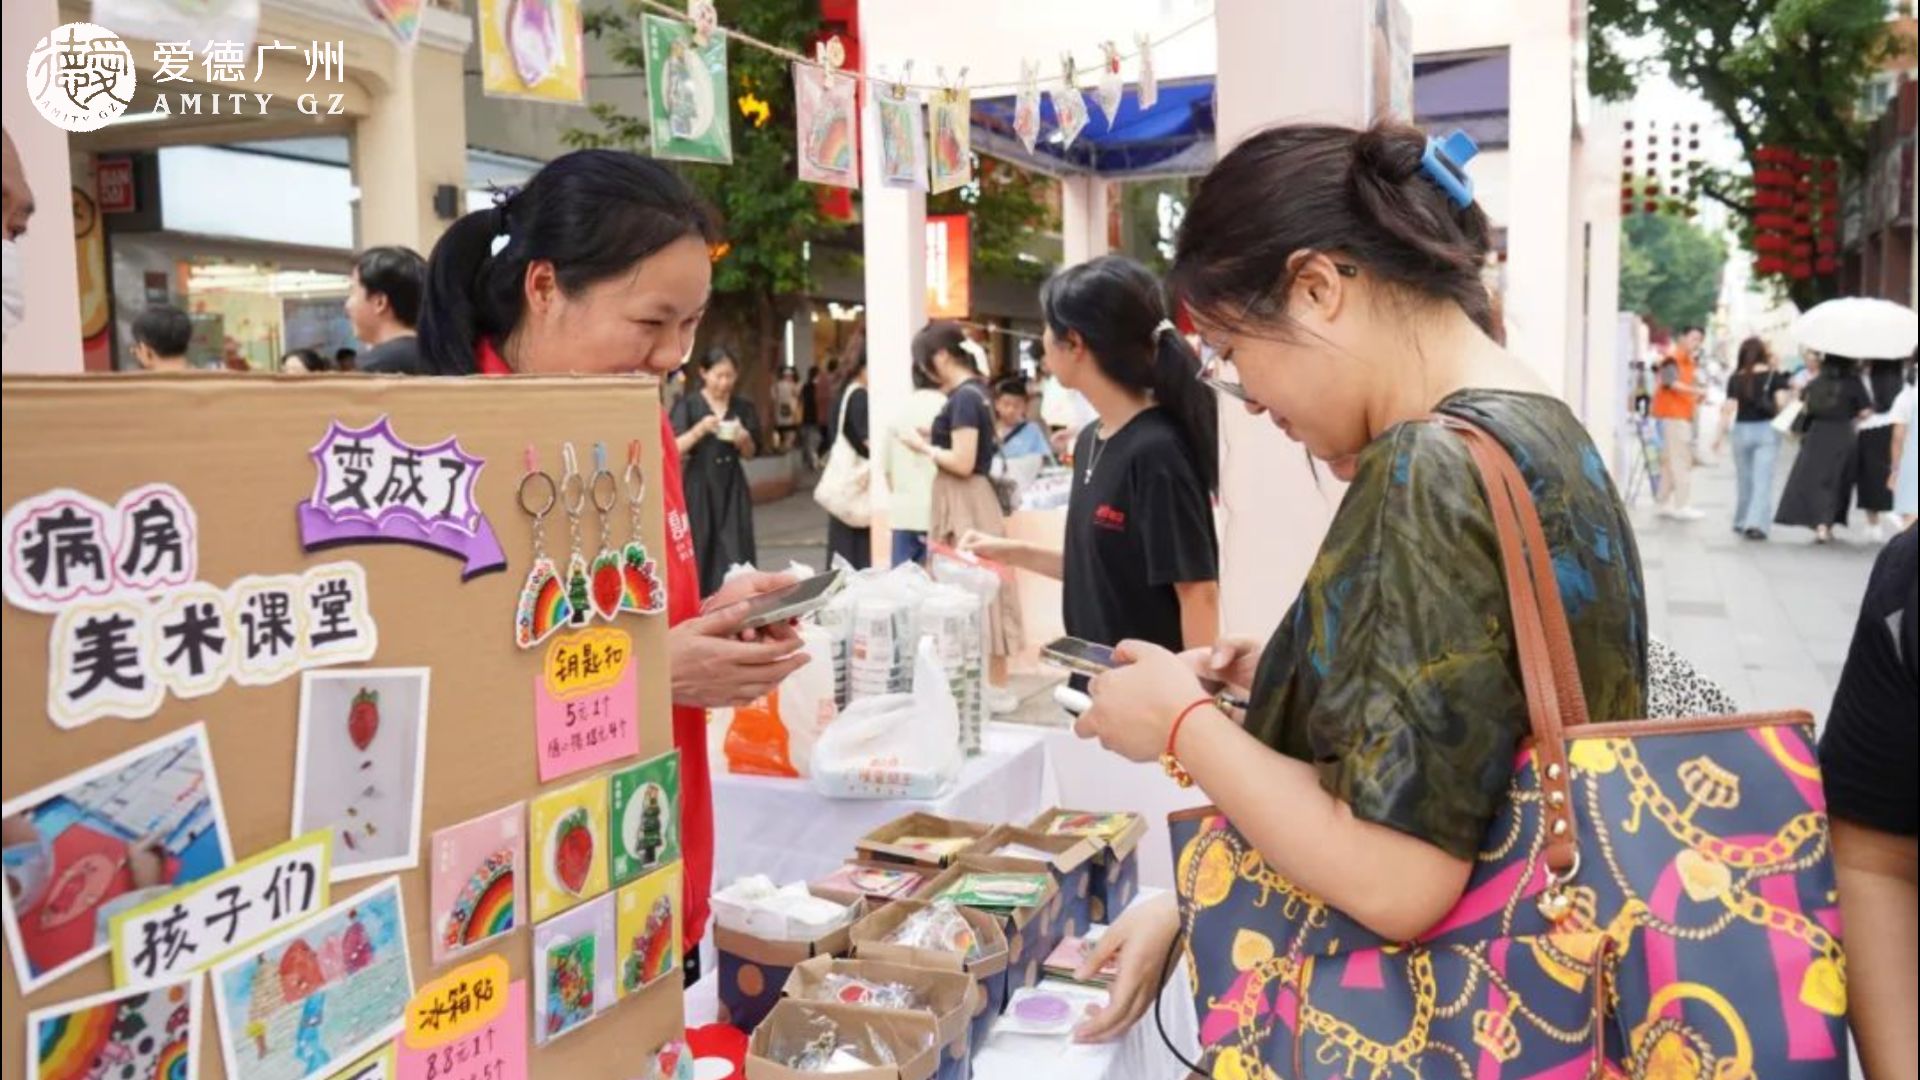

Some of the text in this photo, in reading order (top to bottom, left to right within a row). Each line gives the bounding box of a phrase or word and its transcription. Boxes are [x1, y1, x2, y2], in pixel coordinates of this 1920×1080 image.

[327, 439, 466, 517] 变成了
[21, 498, 183, 588] 病房
[68, 578, 358, 700] 美术课堂
[555, 643, 623, 682] 钥匙扣
[133, 861, 315, 977] 孩子们
[418, 978, 494, 1030] 冰箱贴
